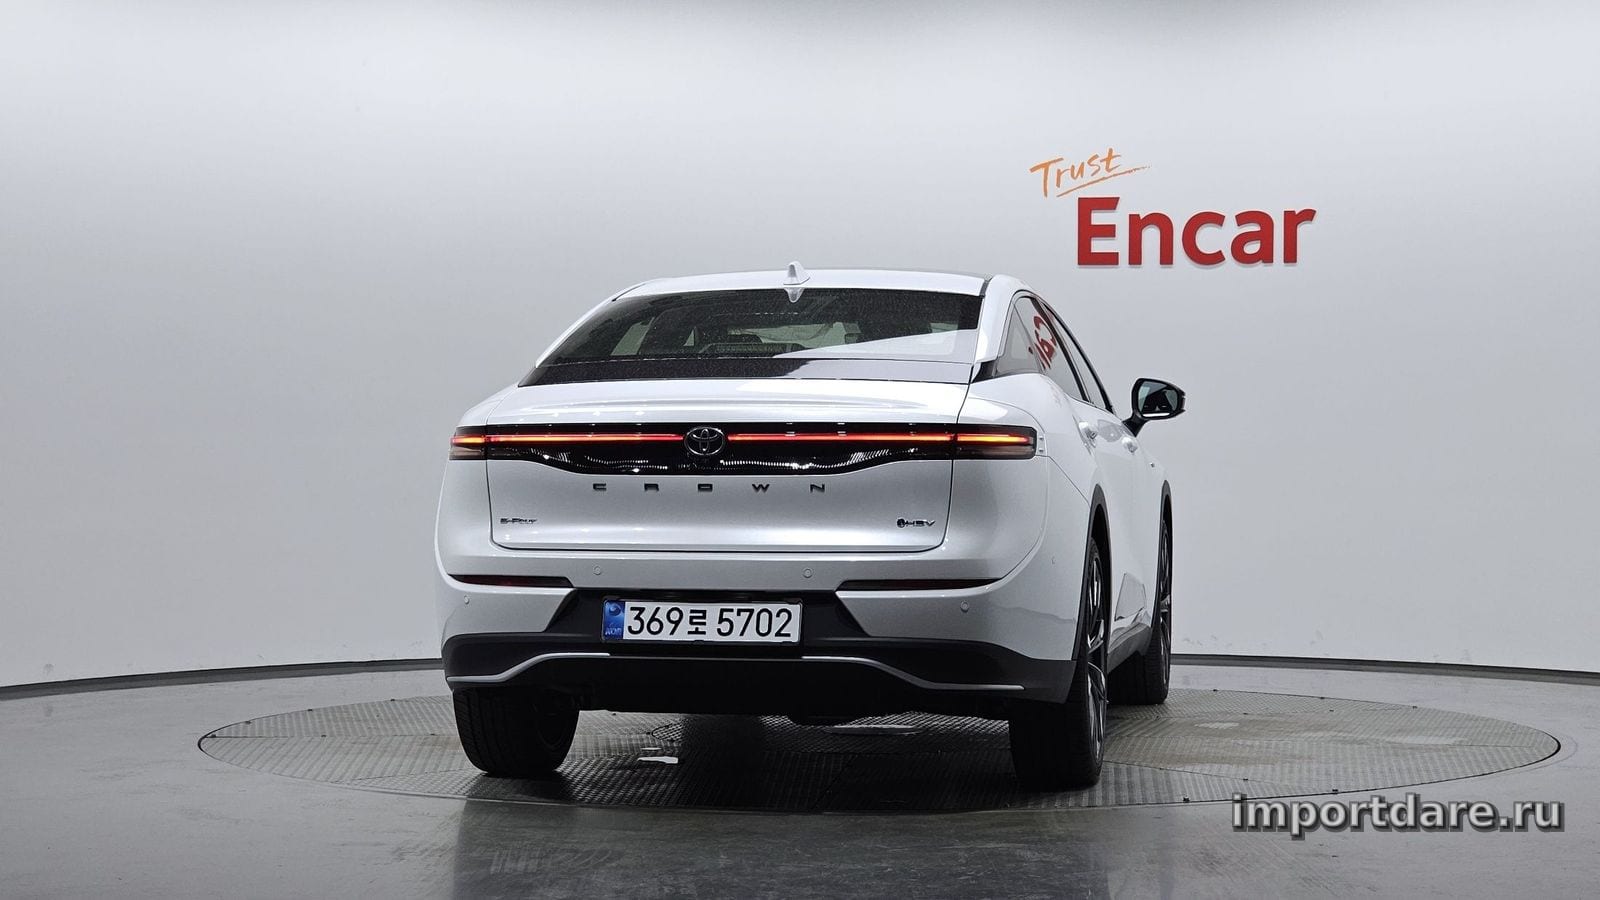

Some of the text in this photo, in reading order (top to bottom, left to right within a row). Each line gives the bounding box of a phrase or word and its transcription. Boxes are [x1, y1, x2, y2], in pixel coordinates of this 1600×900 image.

[1030, 148, 1122, 198] Trust
[1077, 196, 1317, 266] Encar
[592, 482, 826, 493] CROWN
[627, 606, 793, 638] 369로 5702
